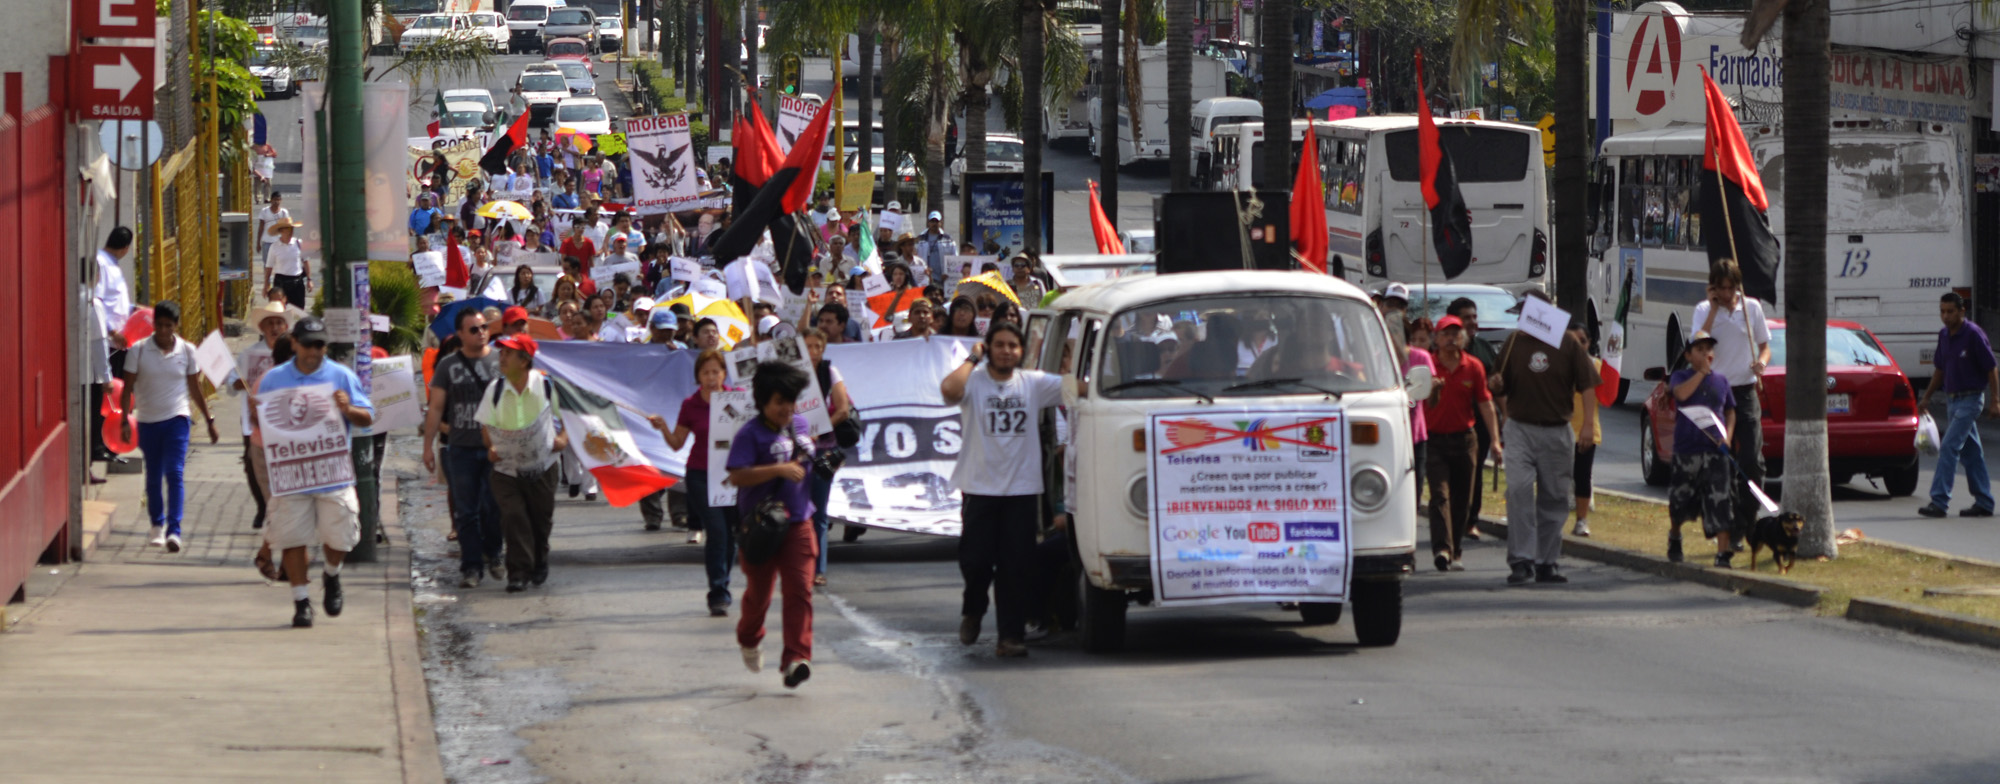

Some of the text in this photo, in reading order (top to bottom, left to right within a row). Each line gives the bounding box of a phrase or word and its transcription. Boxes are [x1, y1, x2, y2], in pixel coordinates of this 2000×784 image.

[296, 15, 309, 25] 20
[1880, 59, 1903, 91] LA
[1912, 63, 1966, 96] LUNA
[92, 104, 142, 116] SALIDA
[627, 113, 688, 133] morena
[637, 194, 697, 207] Cuernavaca
[977, 217, 1024, 227] Planes Telcel
[1839, 248, 1871, 278] 13
[1909, 277, 1951, 288] 161315P
[988, 410, 1027, 433] 132
[267, 435, 347, 460] Televisa
[855, 421, 918, 463] YO
[1167, 454, 1221, 465] Televisa
[303, 462, 316, 487] DE
[1191, 470, 1318, 483] ¿Creen que por publicar
[838, 471, 962, 512] 13
[1180, 484, 1226, 494] mentiras
[1229, 483, 1244, 493] les
[1248, 484, 1282, 493] vamos
[1295, 483, 1328, 492] creer?
[1167, 500, 1252, 514] ¡BIENVENIDOS
[1256, 499, 1271, 512] AL
[1274, 499, 1309, 511] SIGLO
[1163, 525, 1220, 545] Google
[1290, 526, 1335, 538] facebook
[1258, 551, 1285, 560] msn
[1167, 565, 1340, 580] Donde la información da la vuelta
[1191, 580, 1201, 590] al
[1203, 578, 1240, 589] mundo
[1243, 579, 1255, 588] en
